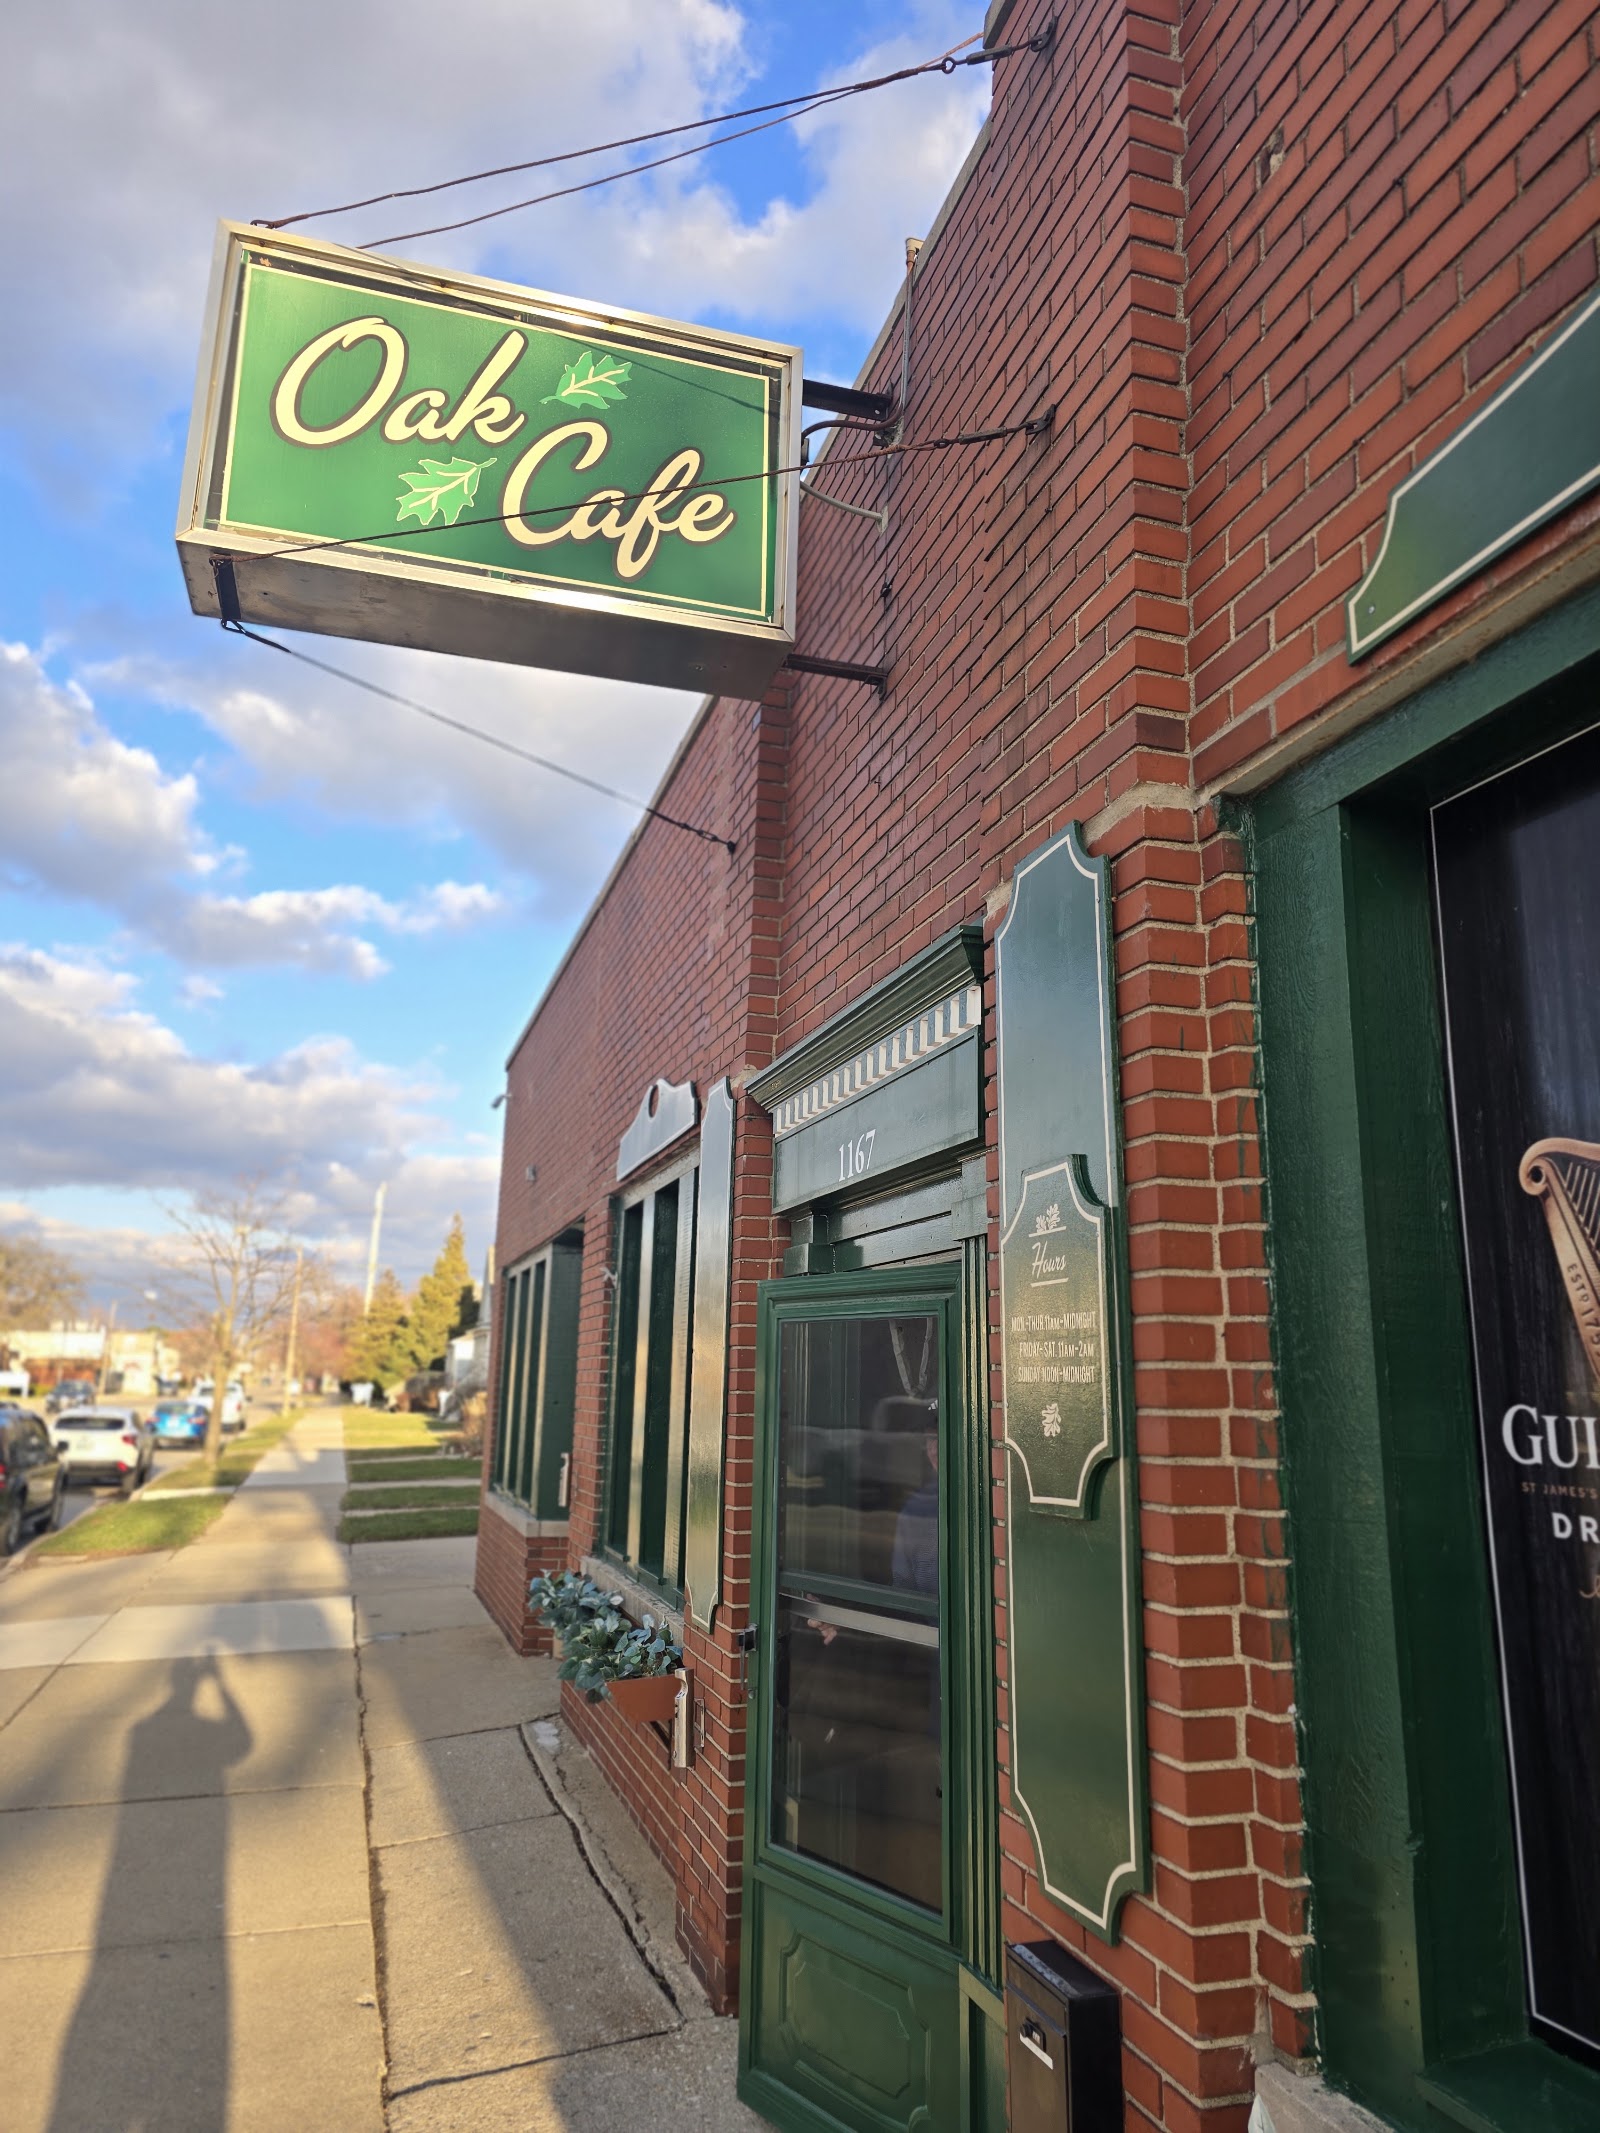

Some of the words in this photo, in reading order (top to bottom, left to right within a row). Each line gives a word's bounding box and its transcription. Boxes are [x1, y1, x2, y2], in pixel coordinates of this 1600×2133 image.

[272, 316, 528, 447] Oak
[501, 420, 736, 581] Cafe
[839, 1129, 876, 1182] 1167
[1032, 1240, 1067, 1279] Hours
[1018, 1366, 1041, 1383] SUNDAY
[1521, 1482, 1535, 1493] ST
